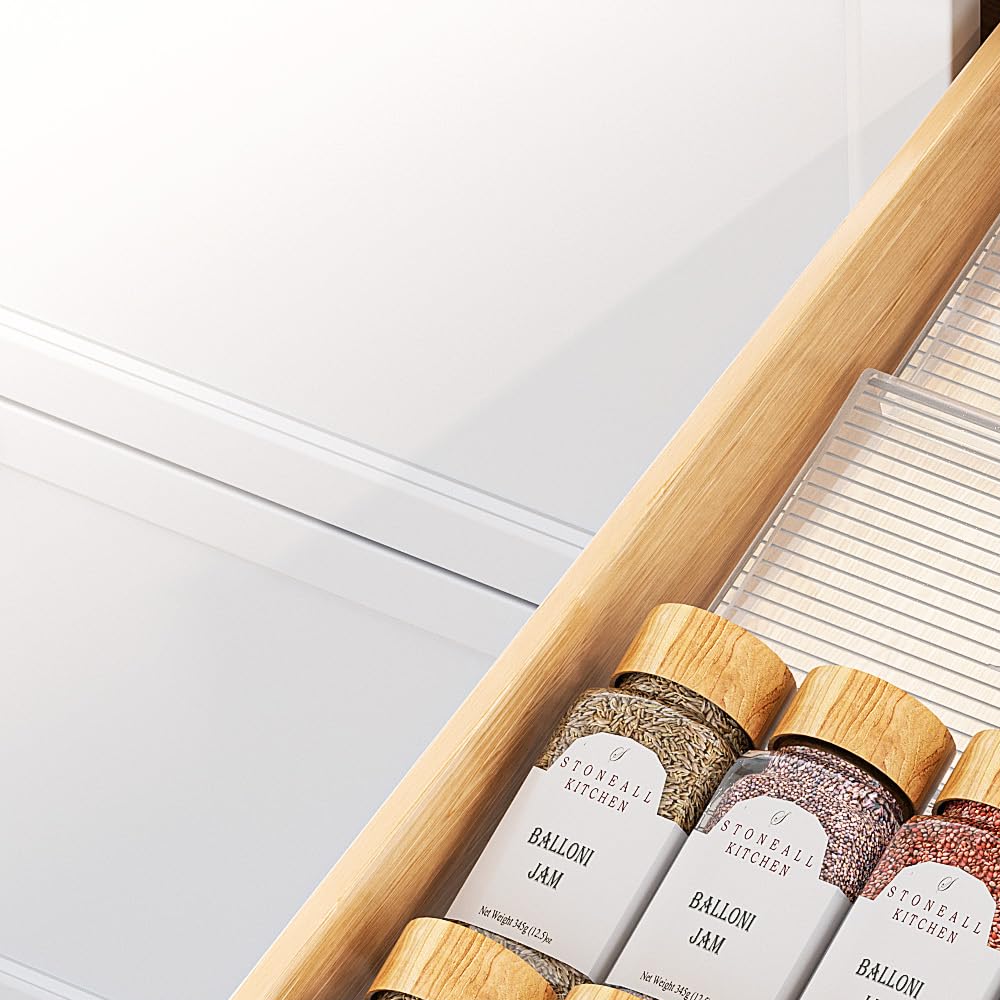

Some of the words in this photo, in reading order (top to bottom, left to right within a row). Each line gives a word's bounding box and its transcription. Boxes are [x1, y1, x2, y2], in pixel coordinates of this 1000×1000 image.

[559, 756, 651, 803] STONEALL
[563, 777, 629, 812] KITCHEN
[526, 826, 595, 867] BALLONI
[720, 819, 813, 867] STONEALL
[724, 841, 790, 877] KITCHEN
[527, 862, 564, 890] JAM
[477, 904, 491, 917] Net
[491, 909, 513, 926] Weight
[511, 918, 529, 935] 345g
[688, 891, 757, 932] BALLONI
[886, 885, 981, 934] STONEALL
[891, 907, 958, 943] KITCHEN
[688, 927, 726, 955] JAM
[639, 970, 653, 982] Net
[652, 974, 675, 991] Weight
[673, 984, 691, 1000] 345g
[855, 958, 925, 1000] BALLONI
